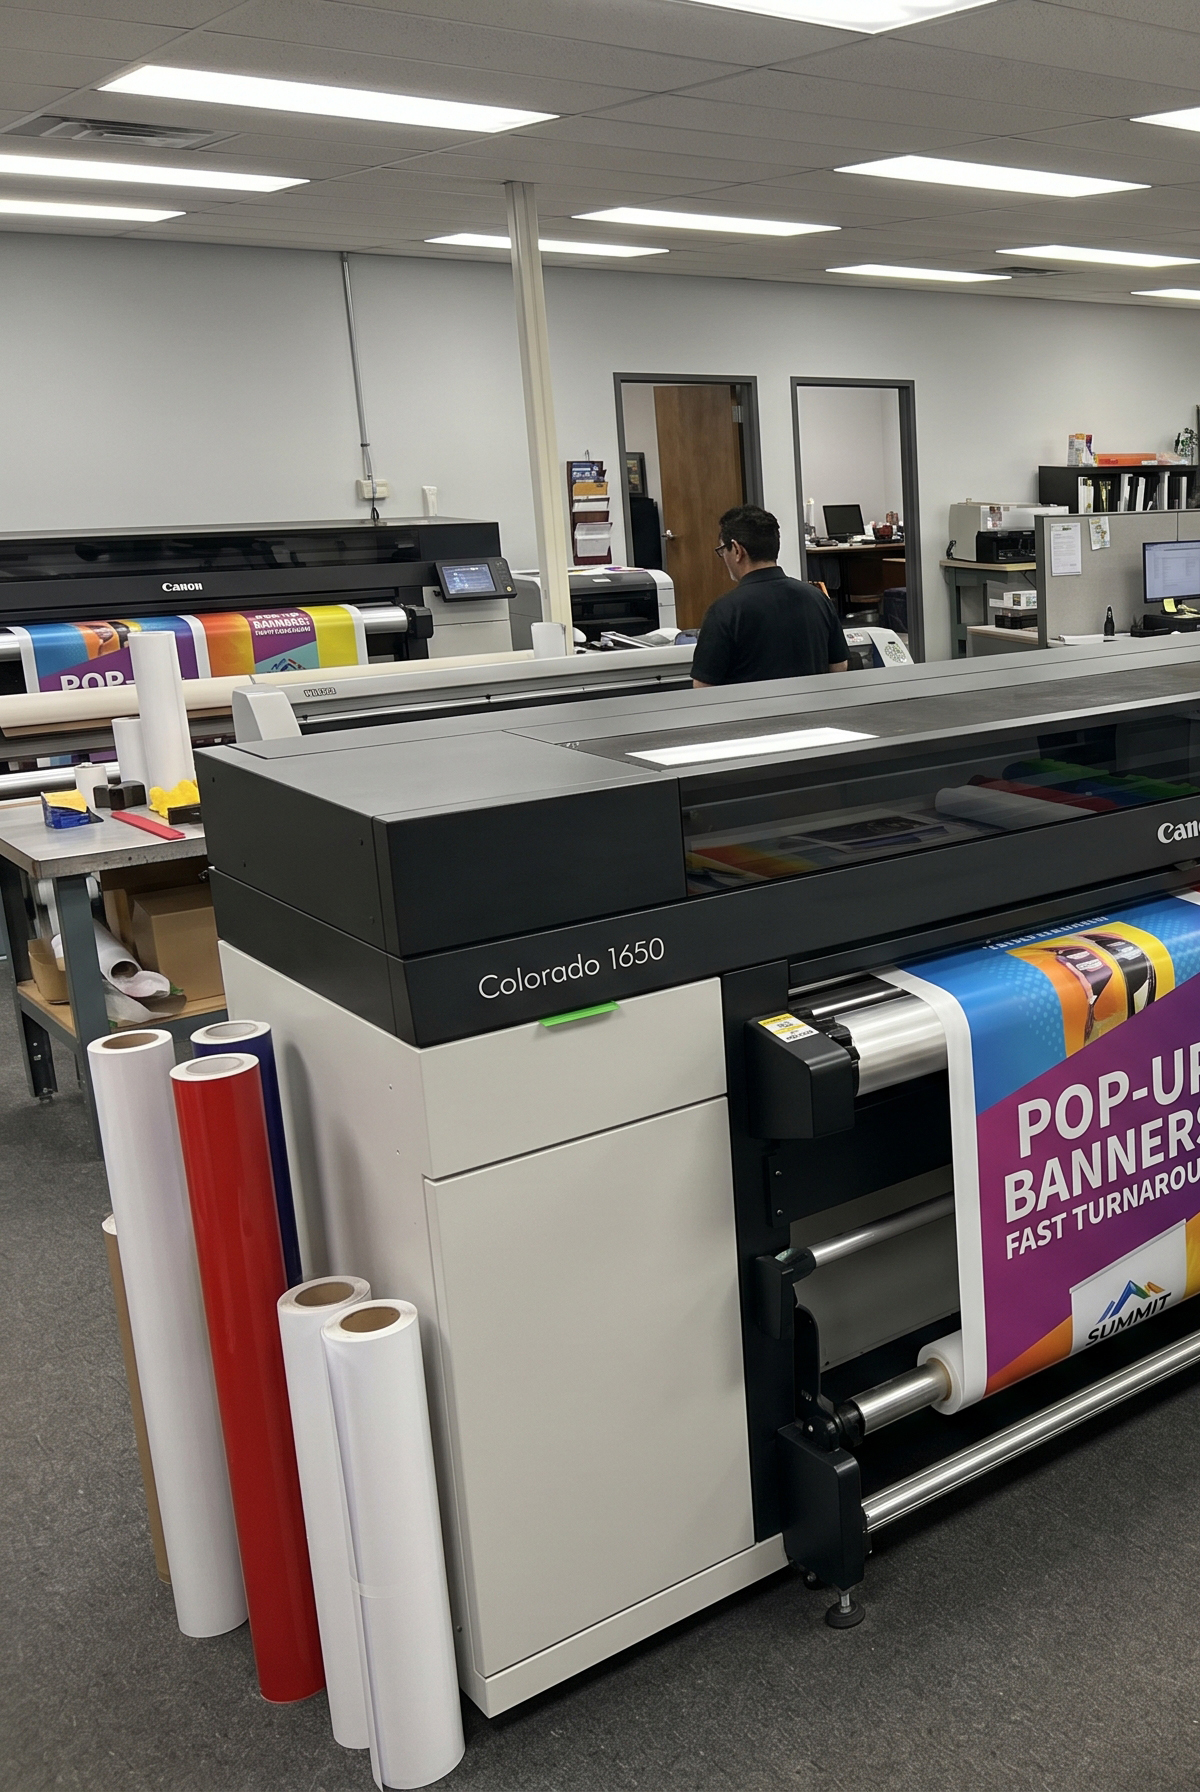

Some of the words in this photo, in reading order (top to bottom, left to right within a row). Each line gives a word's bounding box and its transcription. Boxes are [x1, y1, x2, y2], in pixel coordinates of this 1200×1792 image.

[60, 671, 135, 691] POP-
[478, 953, 600, 999] Colorado
[608, 937, 665, 970] 1650
[1006, 1212, 1067, 1260] FAST
[1085, 1292, 1172, 1346] SUMMIT
